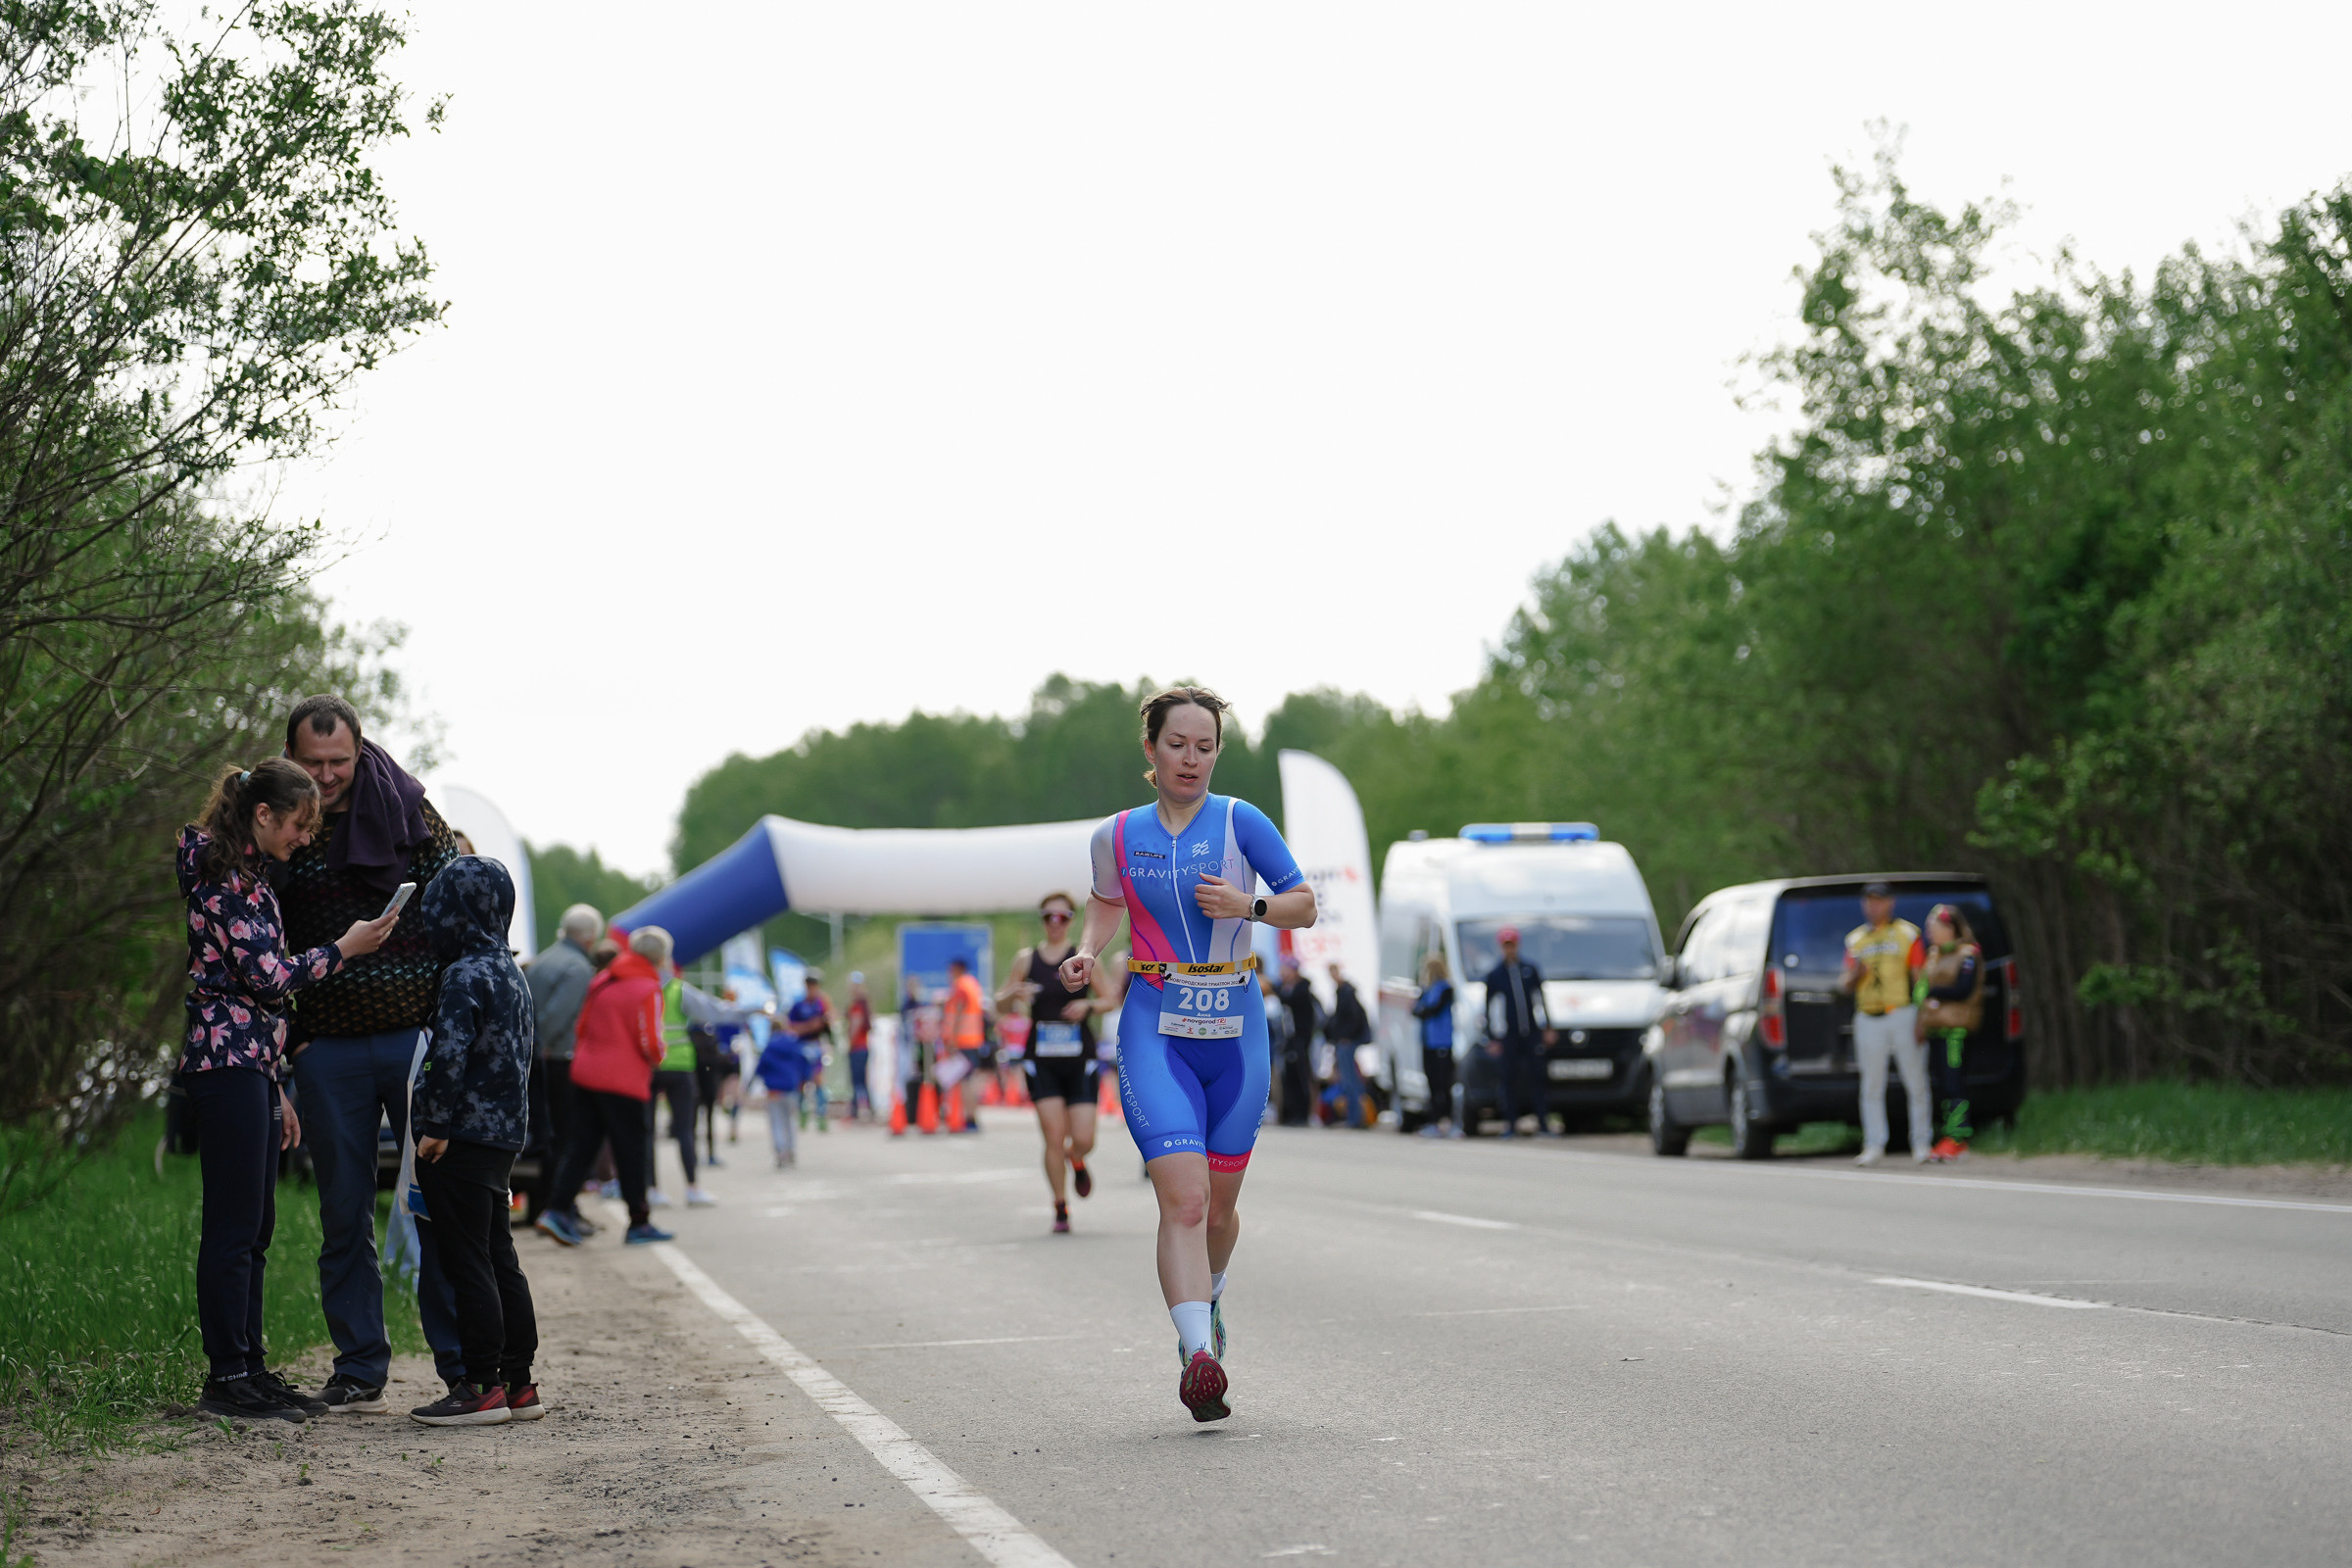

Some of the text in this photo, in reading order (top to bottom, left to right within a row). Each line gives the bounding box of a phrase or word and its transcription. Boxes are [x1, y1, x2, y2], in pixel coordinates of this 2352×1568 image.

[1129, 858, 1234, 880] GRAVITYSPORT
[1178, 987, 1230, 1011] 208
[1116, 1048, 1150, 1128] GRAVITYSPORT
[1207, 1156, 1249, 1168] ITYSPORT
